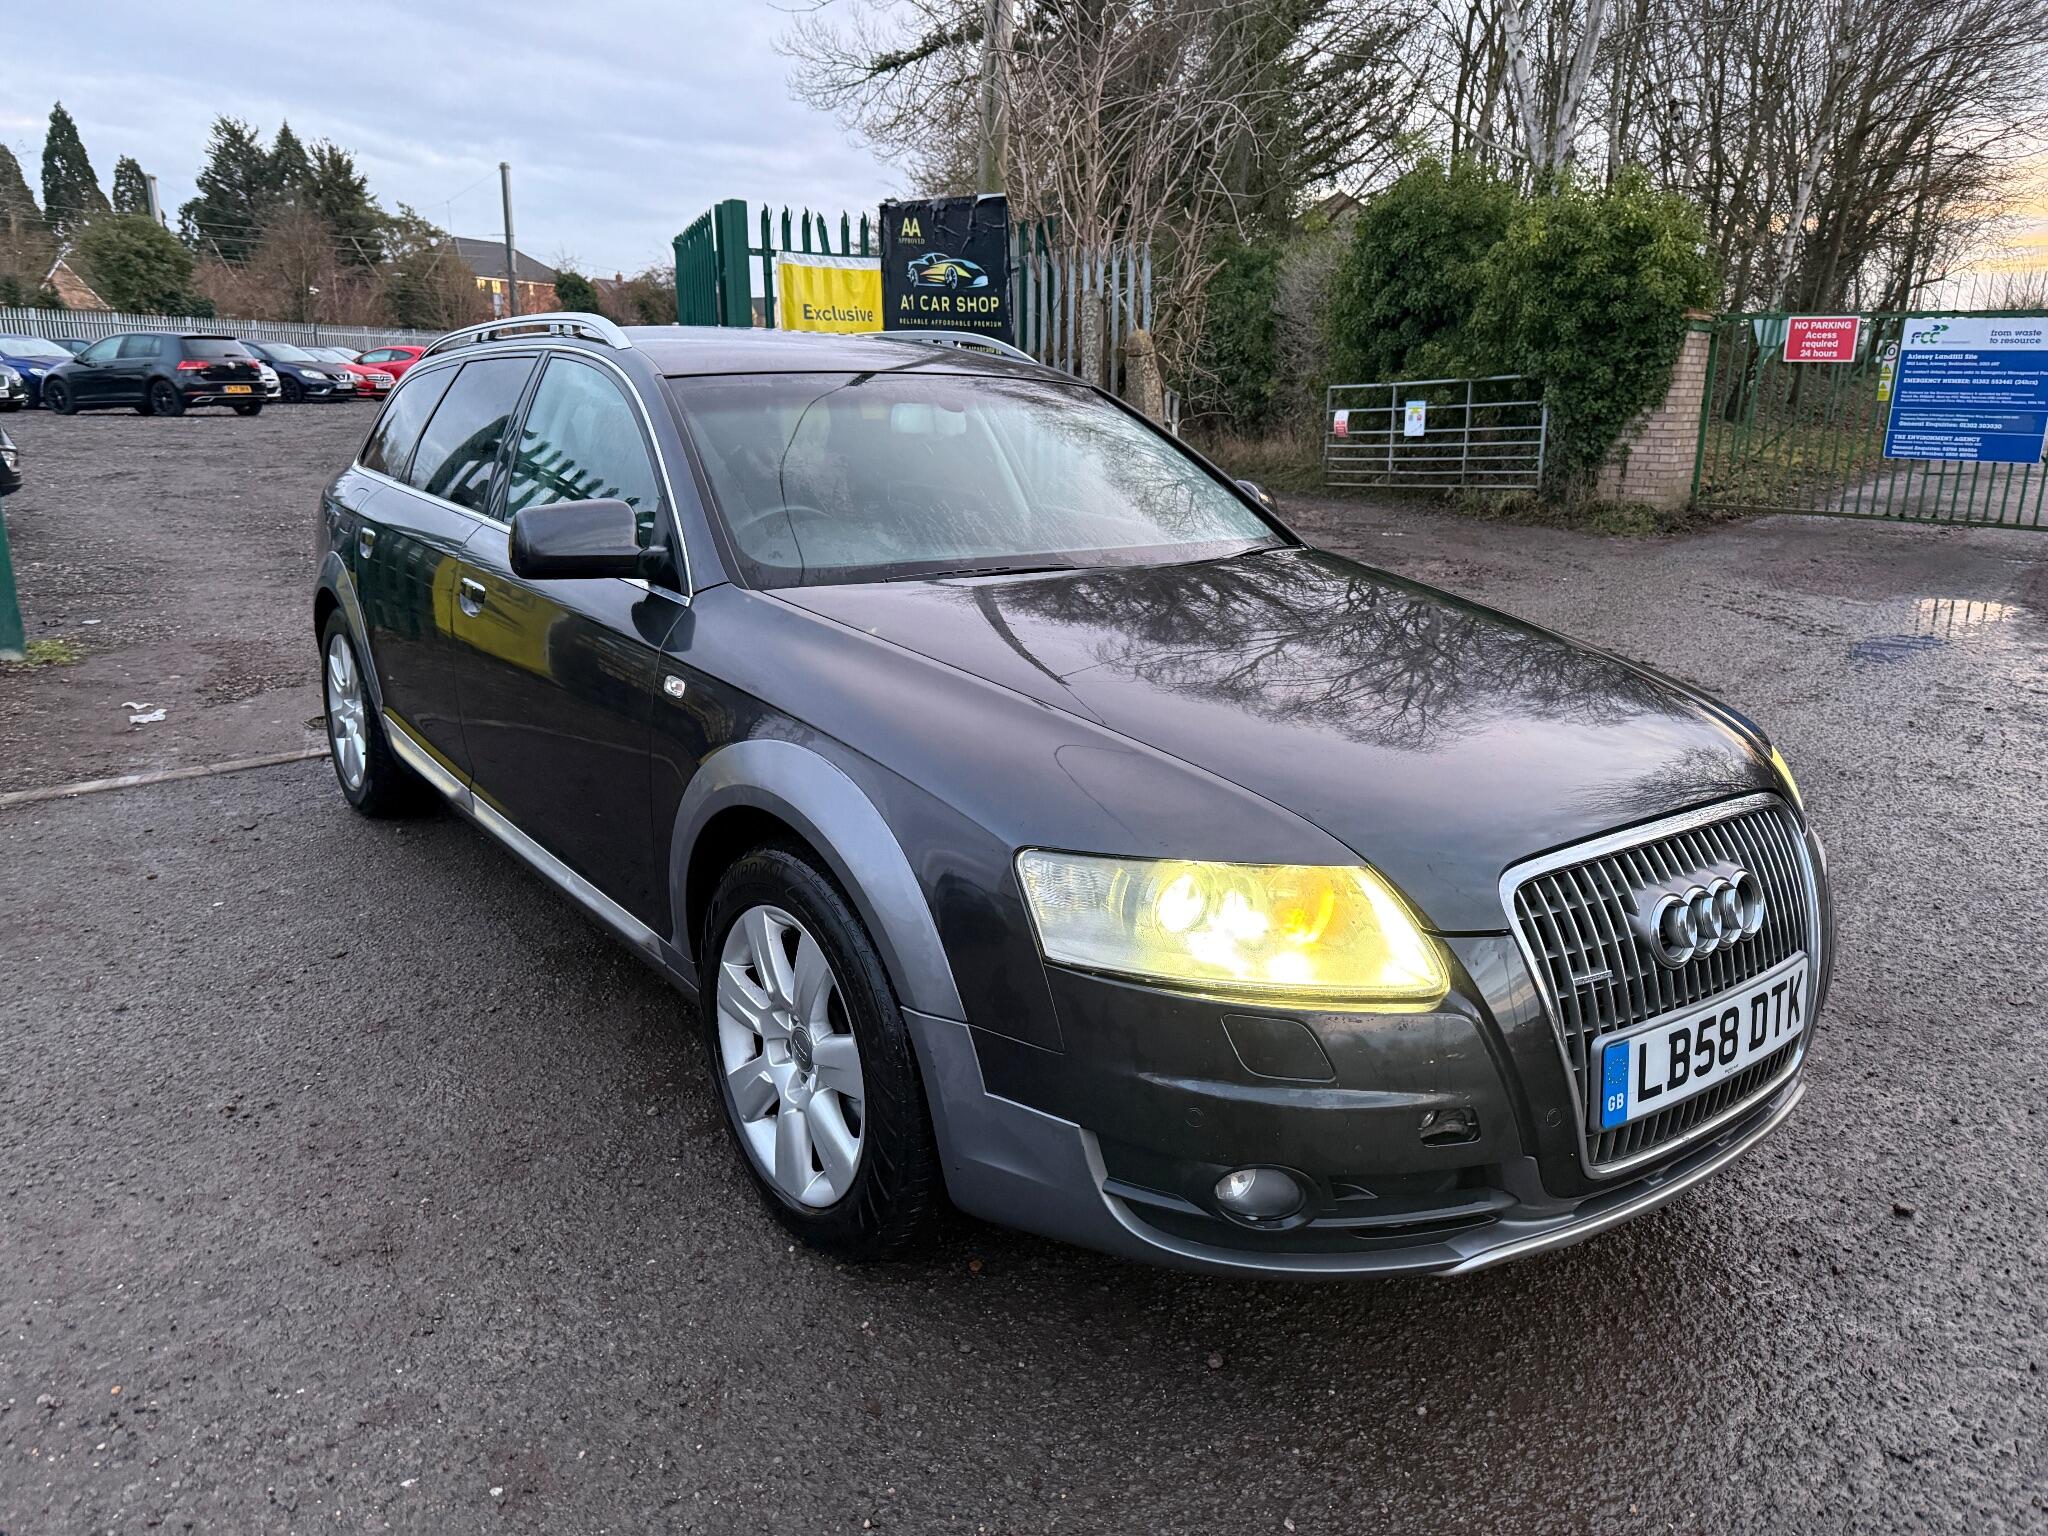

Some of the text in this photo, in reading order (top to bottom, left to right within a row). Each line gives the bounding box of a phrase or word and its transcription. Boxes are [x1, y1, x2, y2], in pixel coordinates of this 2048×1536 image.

[901, 217, 922, 237] AA
[900, 294, 1000, 312] A1 CAR SHOP
[803, 304, 873, 322] Exclusive
[931, 319, 970, 327] AFFORDABLE
[973, 320, 1002, 328] PREMIUM
[1794, 321, 1852, 330] NO PARKING
[1802, 340, 1838, 348] required
[1910, 332, 1940, 344] FCC
[1637, 969, 1804, 1103] LB58 DTK
[1608, 1092, 1624, 1112] GB
